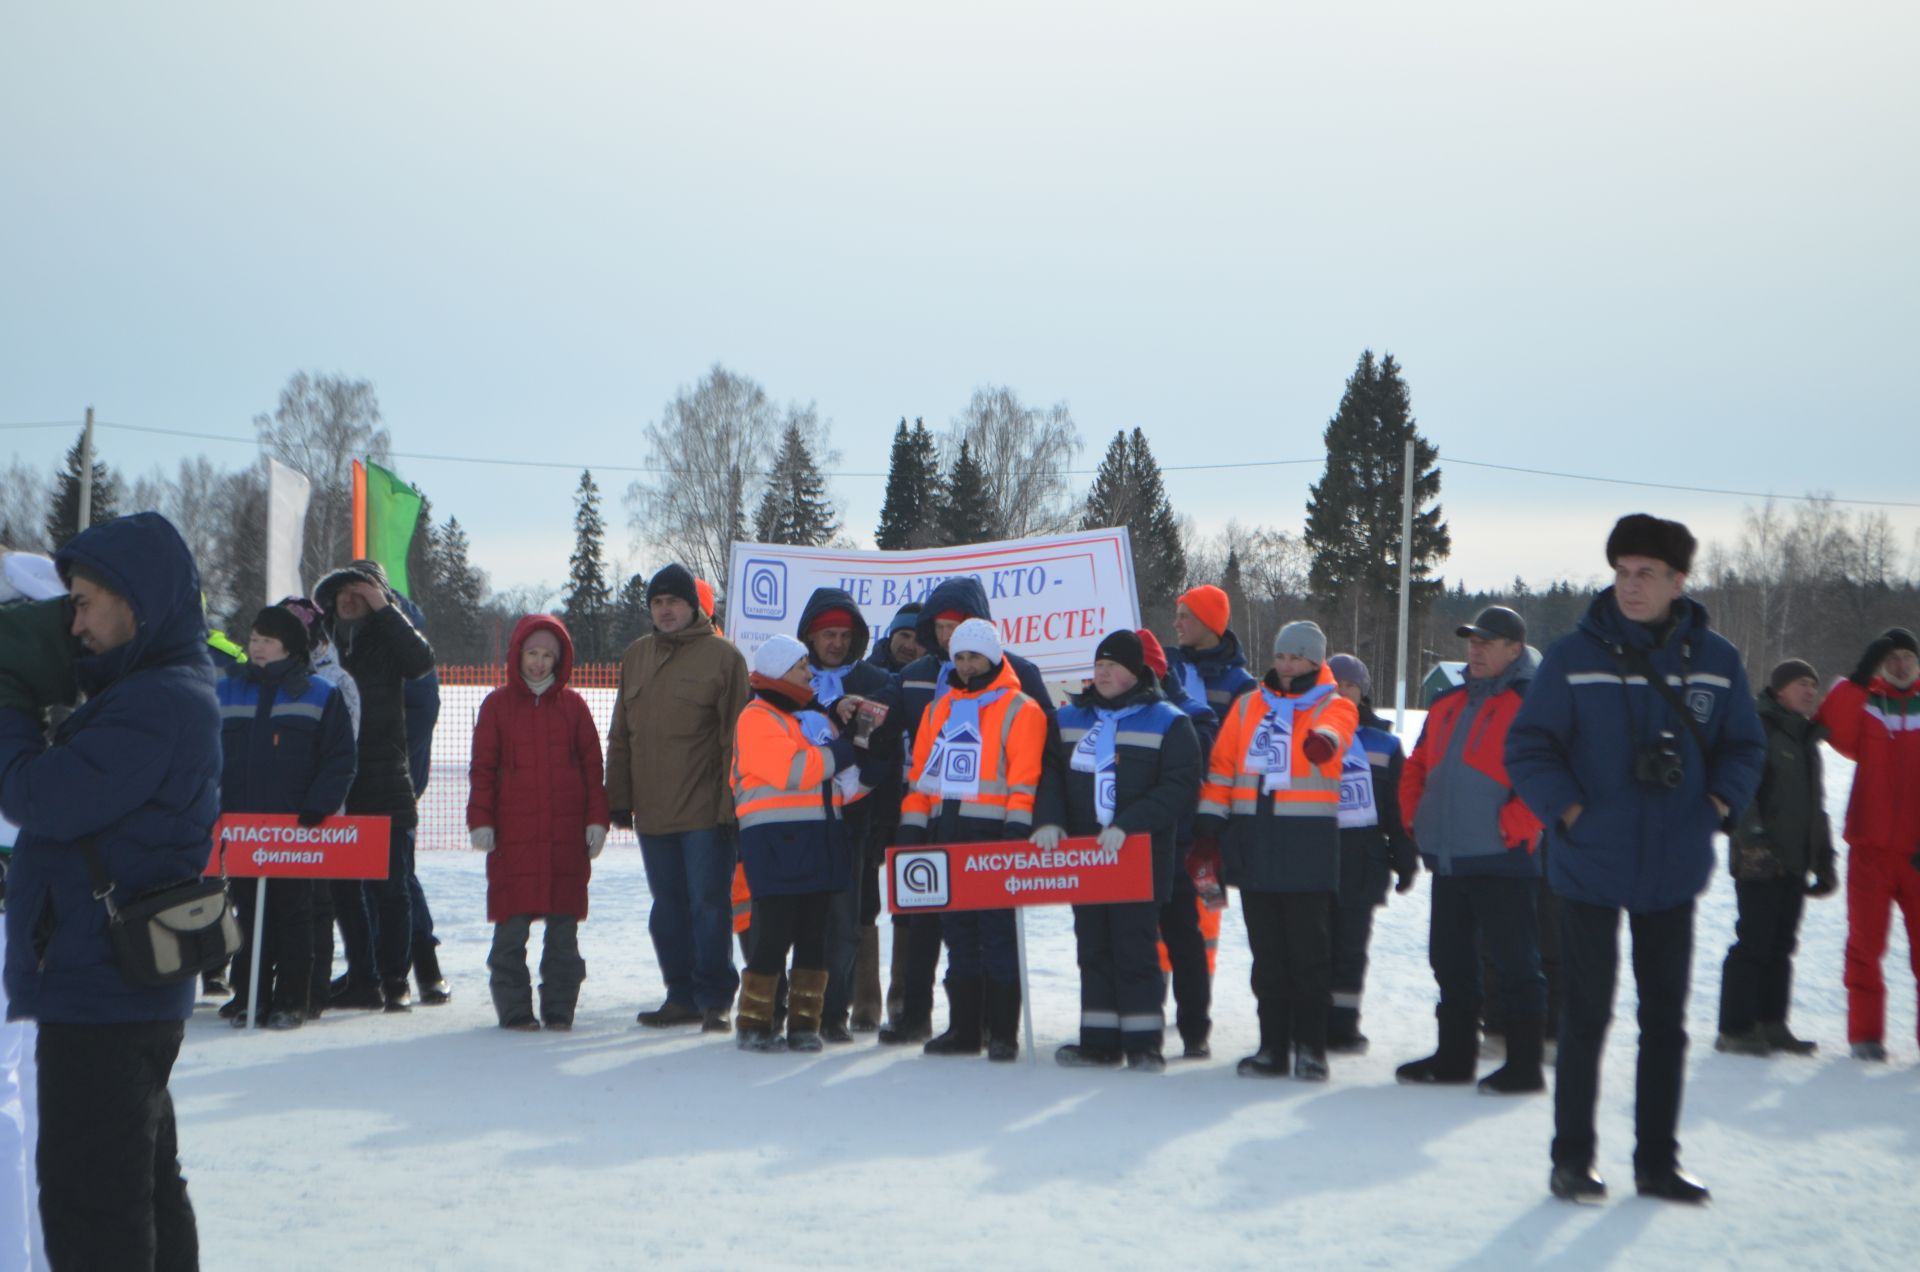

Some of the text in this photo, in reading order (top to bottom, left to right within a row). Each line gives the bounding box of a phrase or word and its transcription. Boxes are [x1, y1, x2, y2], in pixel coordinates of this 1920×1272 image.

[839, 577, 873, 606] НЕ
[881, 573, 982, 606] ВАЖ
[990, 566, 1046, 599] КТО
[992, 606, 1105, 646] МЕСТЕ!
[220, 825, 358, 844] АПАСТОВСКИЙ
[252, 847, 324, 866] филиал
[964, 850, 1119, 872] АКСУБАЕВСКИЙ
[1004, 874, 1080, 895] филиал
